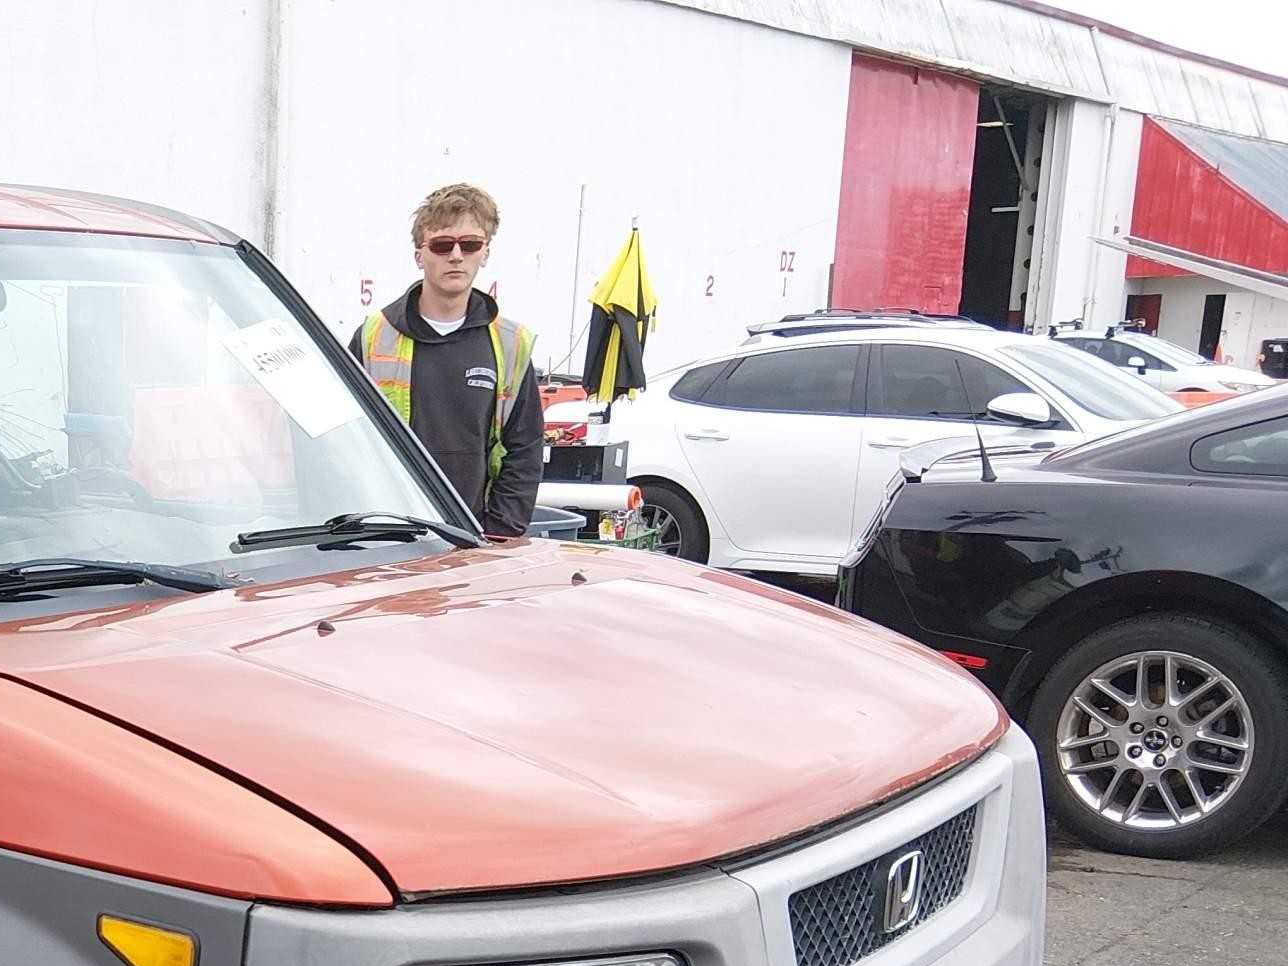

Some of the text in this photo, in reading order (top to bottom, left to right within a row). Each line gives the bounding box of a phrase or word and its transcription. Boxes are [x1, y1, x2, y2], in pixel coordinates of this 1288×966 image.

[780, 251, 796, 272] DZ
[360, 279, 373, 307] 5
[488, 280, 498, 301] 4
[705, 274, 715, 297] 2
